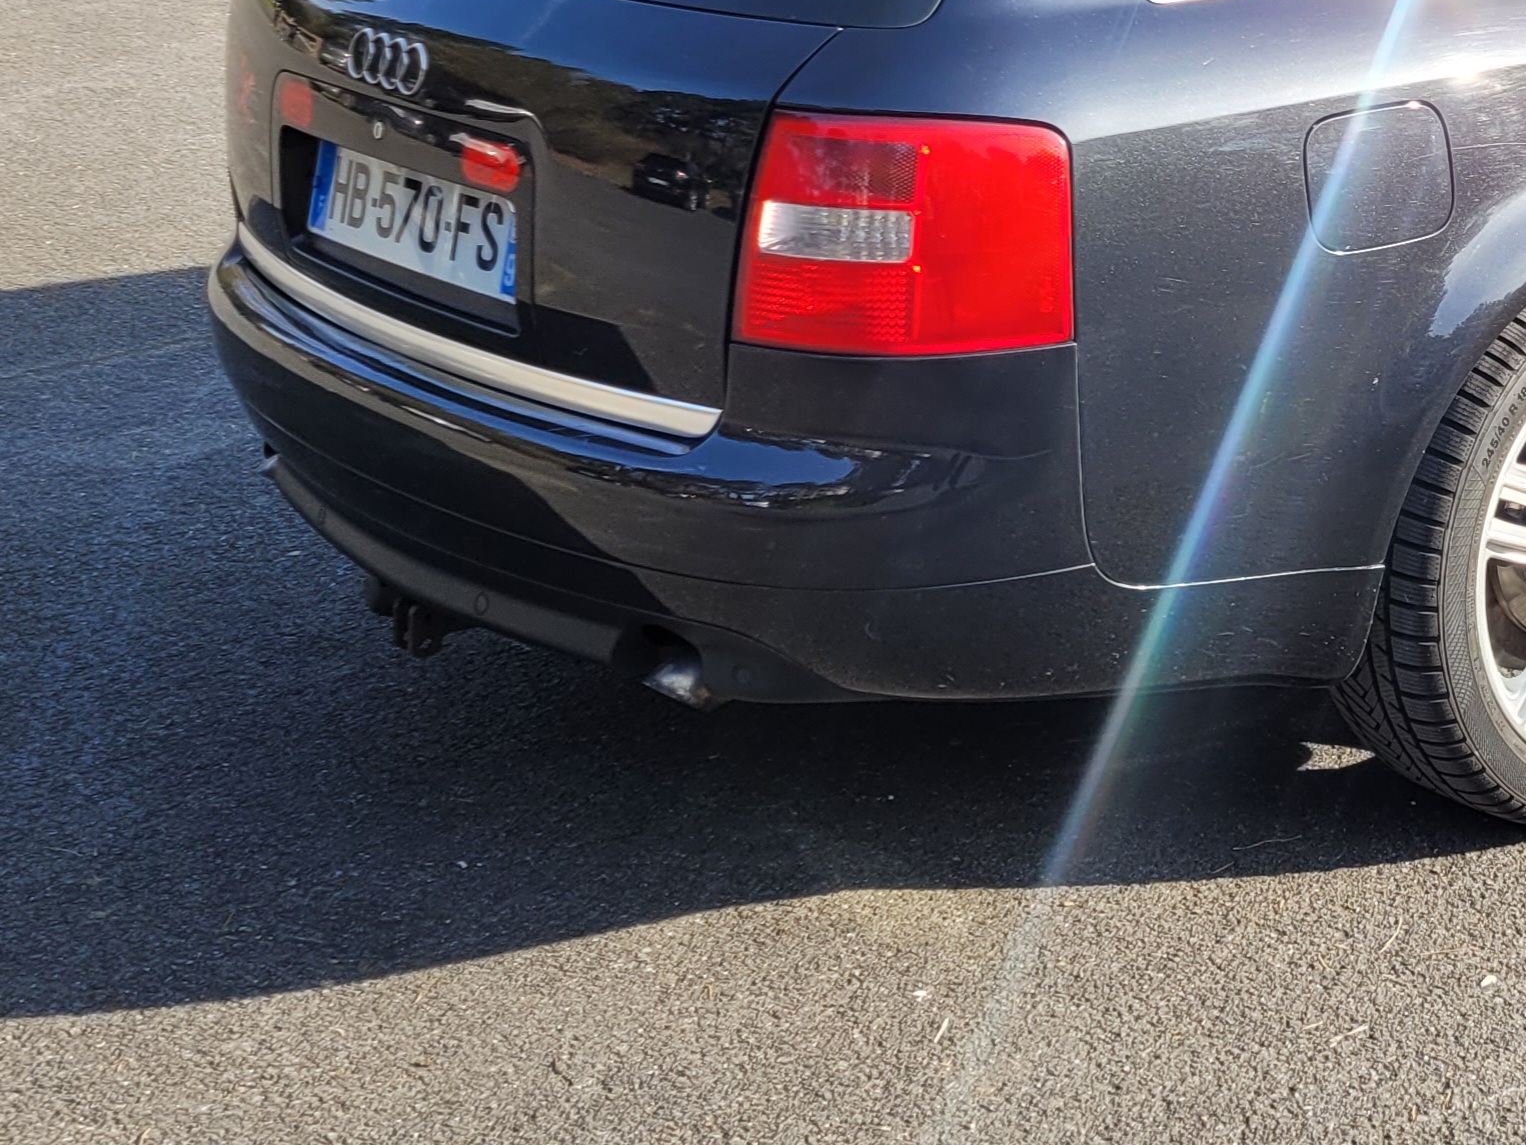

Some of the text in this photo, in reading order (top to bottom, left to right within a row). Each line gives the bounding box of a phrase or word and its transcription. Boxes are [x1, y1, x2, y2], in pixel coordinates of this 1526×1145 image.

[329, 154, 503, 271] HB-570-FS
[1481, 416, 1512, 470] 245/40
[1509, 403, 1520, 416] R
